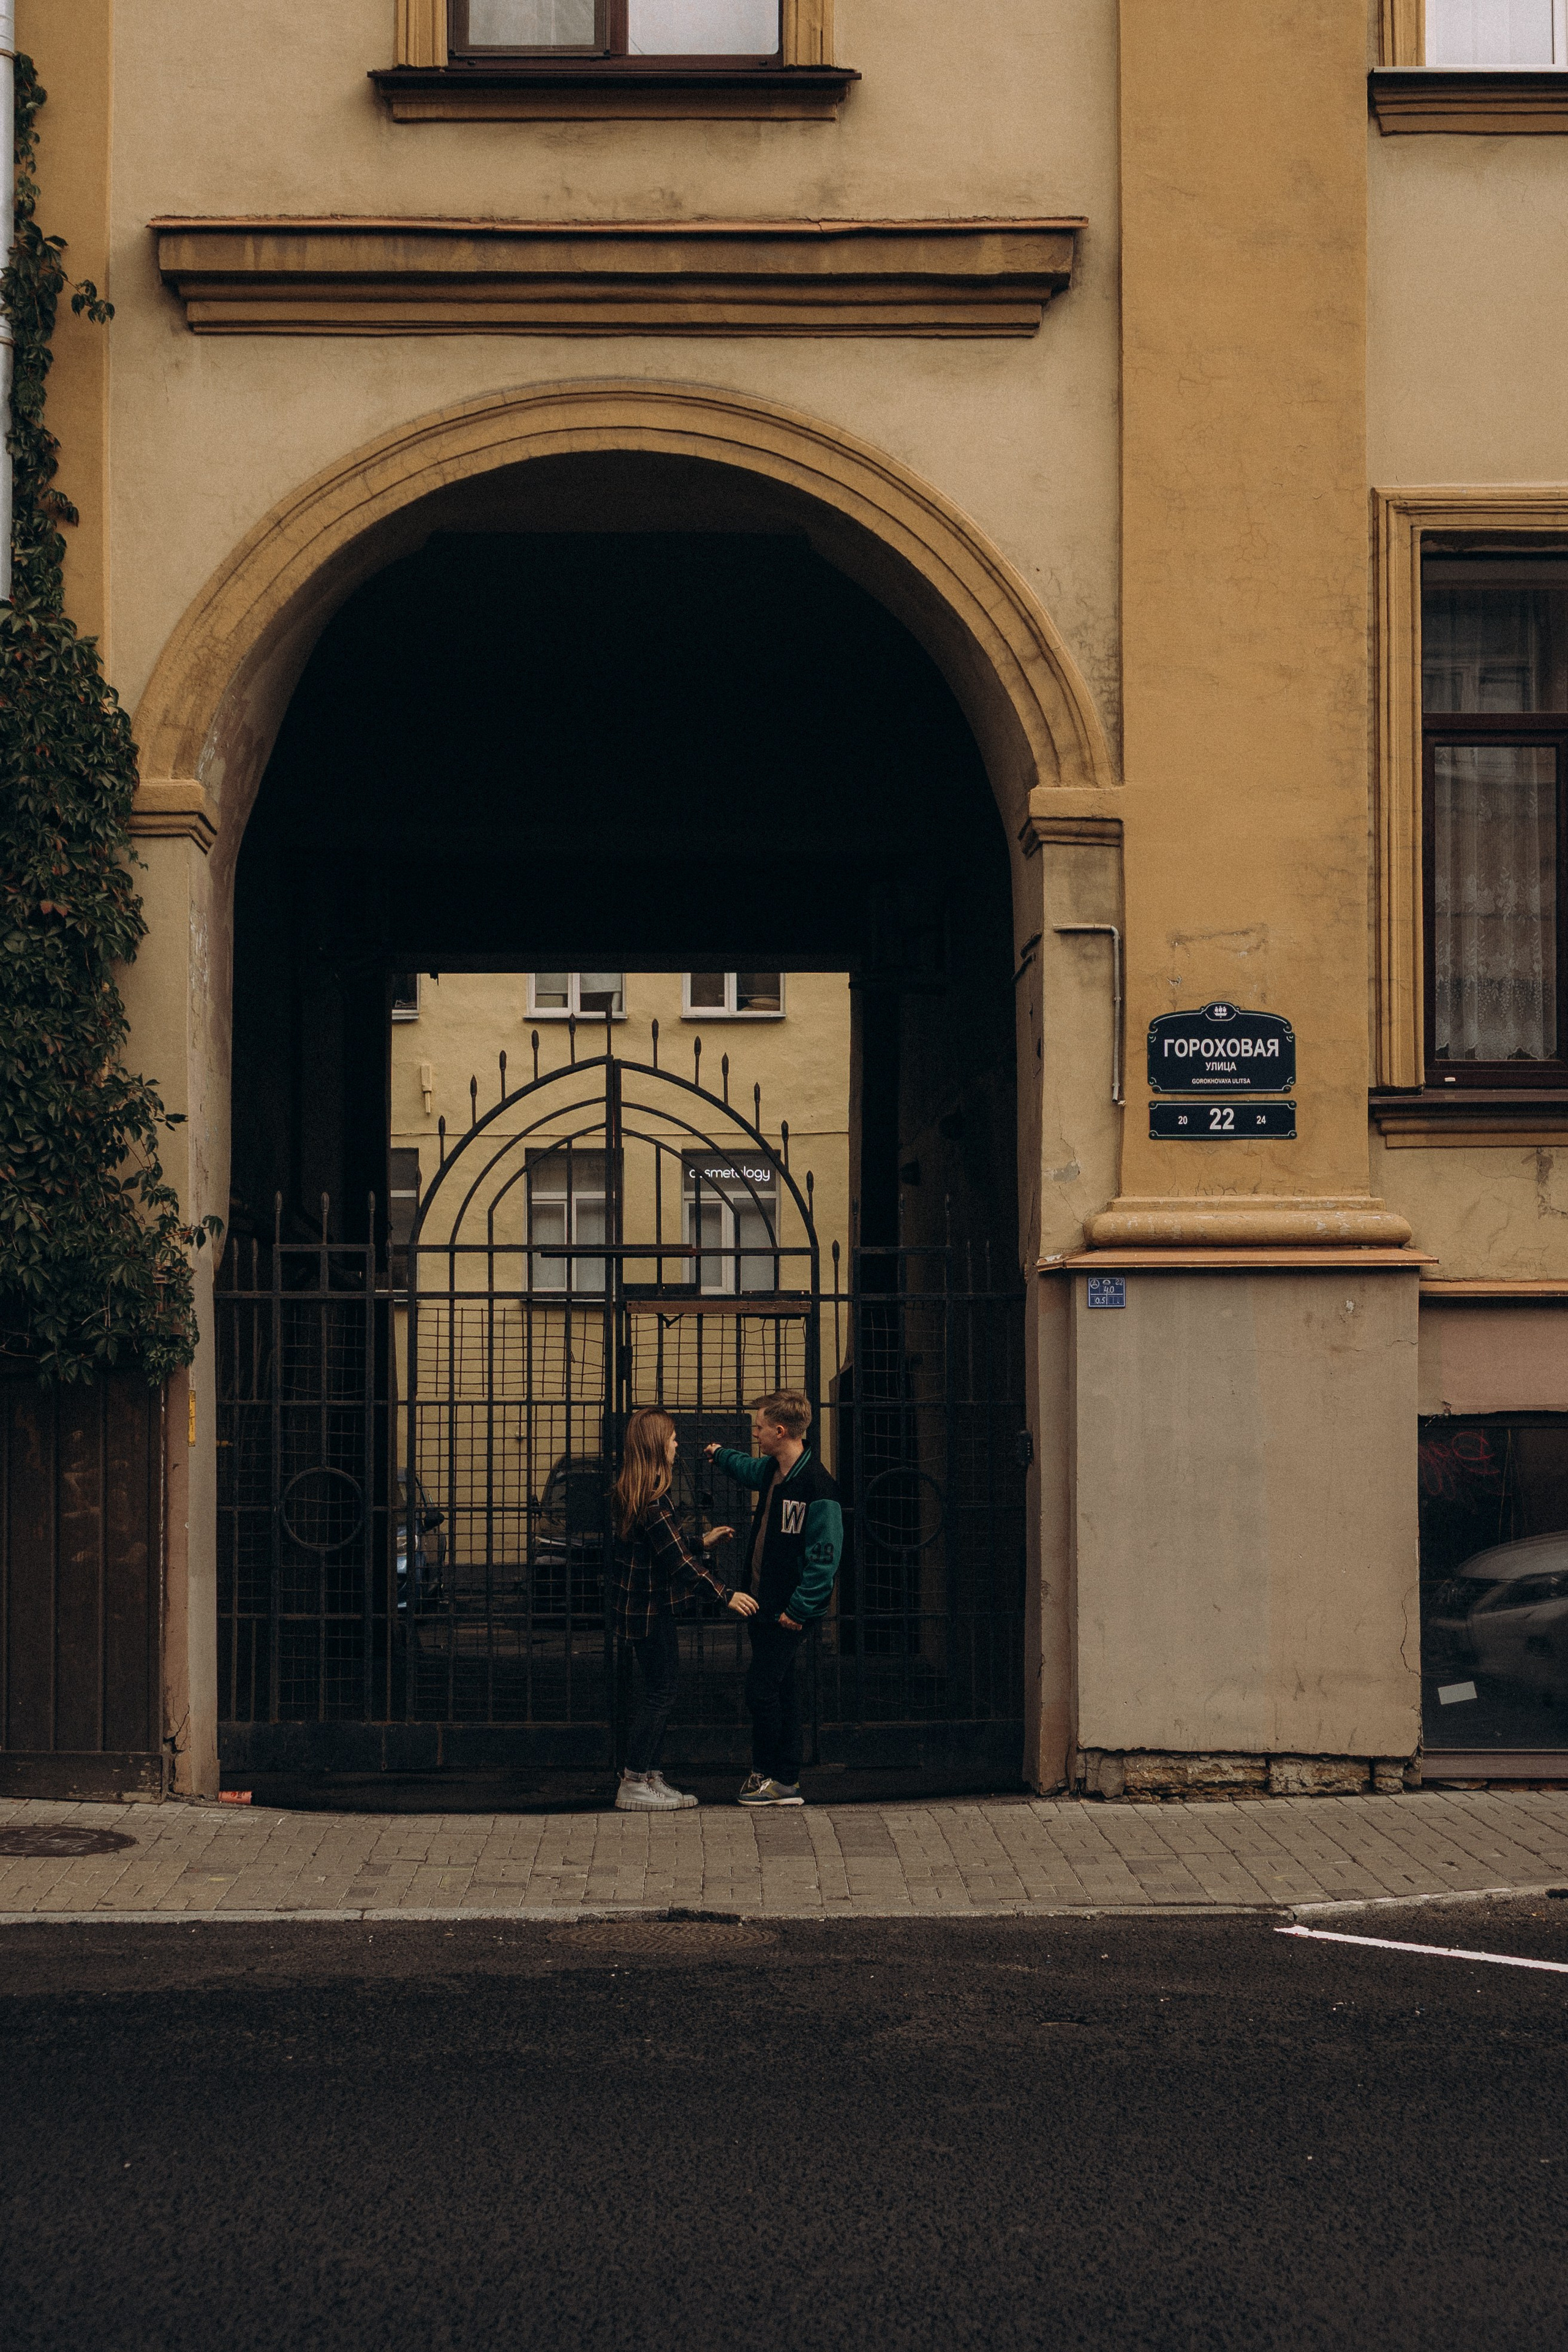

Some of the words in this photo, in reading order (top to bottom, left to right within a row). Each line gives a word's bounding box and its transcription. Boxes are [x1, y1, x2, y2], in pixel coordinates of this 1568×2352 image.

[1164, 1039, 1279, 1057] ГОРОХОВАЯ
[1205, 1061, 1237, 1072] УЛИЦА
[1178, 1116, 1188, 1125] 20
[1209, 1108, 1234, 1129] 22
[1256, 1115, 1266, 1125] 24
[689, 1166, 770, 1182] csmetlogy
[782, 1500, 806, 1534] W
